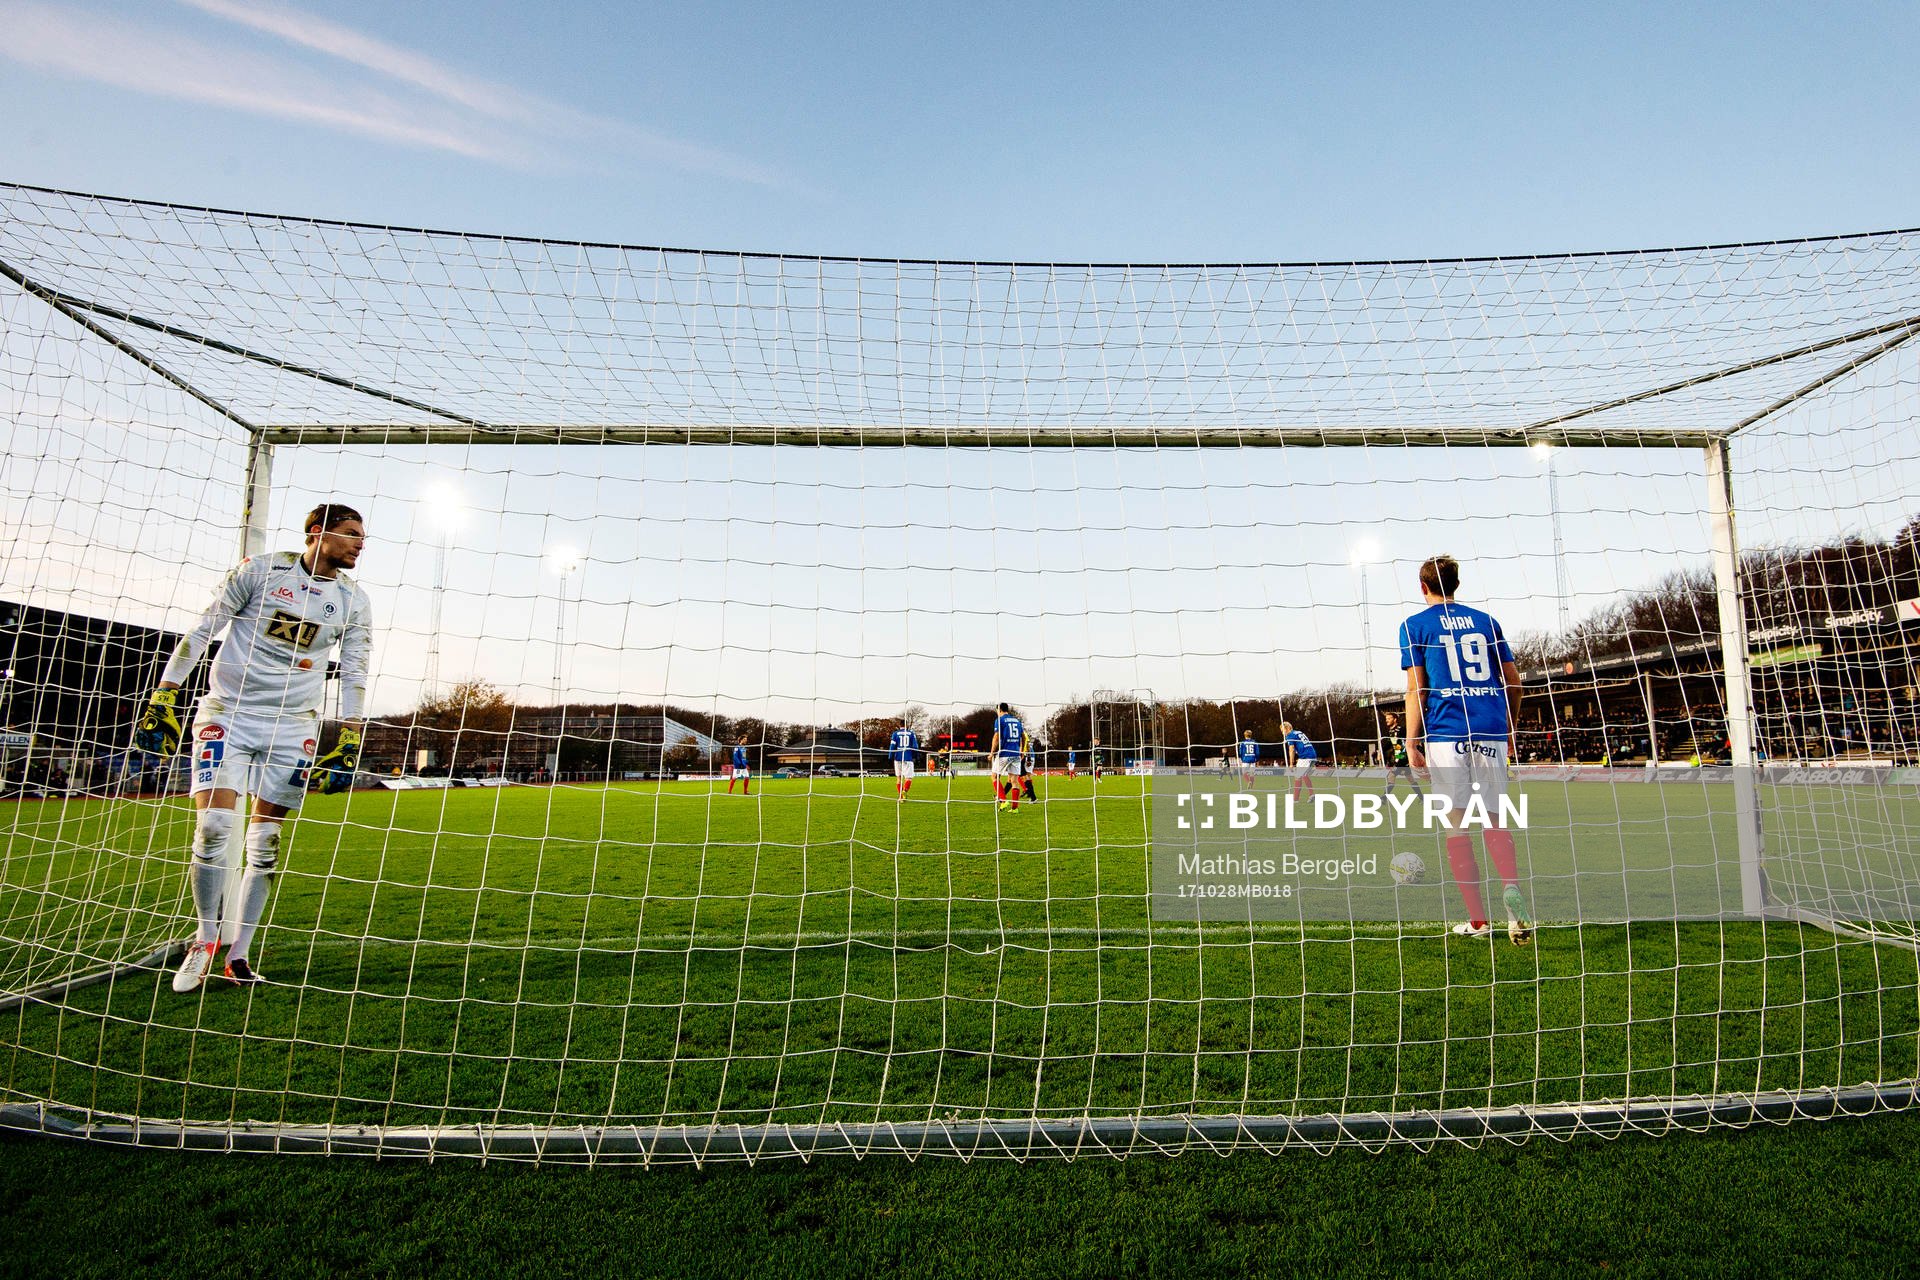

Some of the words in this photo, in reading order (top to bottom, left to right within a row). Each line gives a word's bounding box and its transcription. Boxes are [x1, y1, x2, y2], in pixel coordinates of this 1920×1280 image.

[278, 586, 294, 598] ICA
[1439, 615, 1475, 630] ÖHRN
[271, 615, 309, 648] XL
[1439, 632, 1491, 682] 19
[1008, 723, 1019, 738] 15
[898, 735, 910, 747] 10
[1245, 744, 1255, 754] 16
[198, 770, 213, 783] 22
